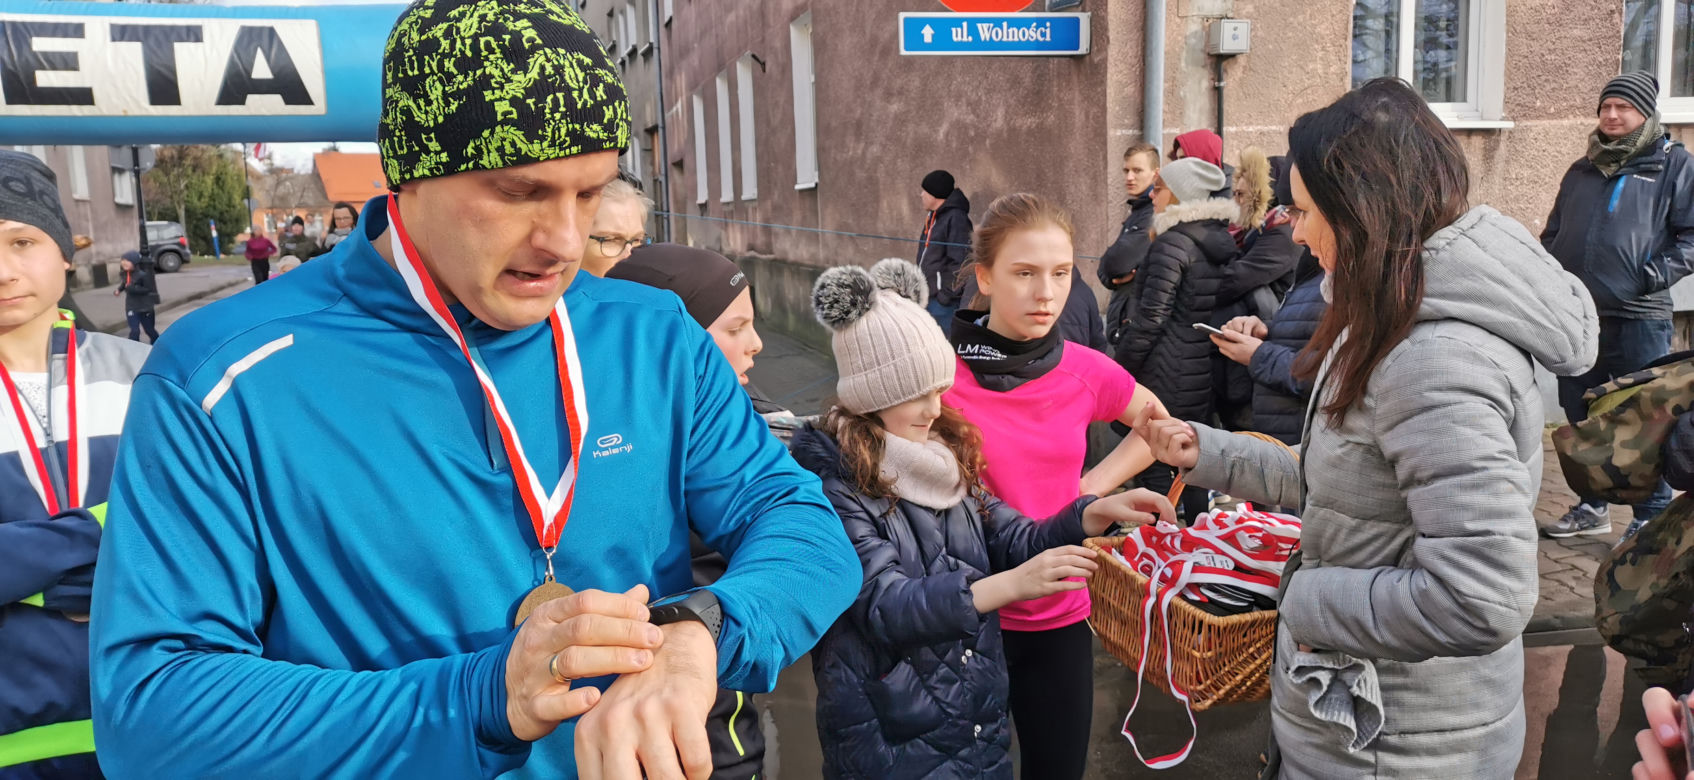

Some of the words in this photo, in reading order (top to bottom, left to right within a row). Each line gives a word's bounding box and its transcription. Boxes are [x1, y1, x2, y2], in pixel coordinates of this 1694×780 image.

[951, 21, 973, 42] ul.
[976, 21, 1052, 42] Wolności
[0, 21, 315, 106] ETA
[957, 343, 979, 354] LM
